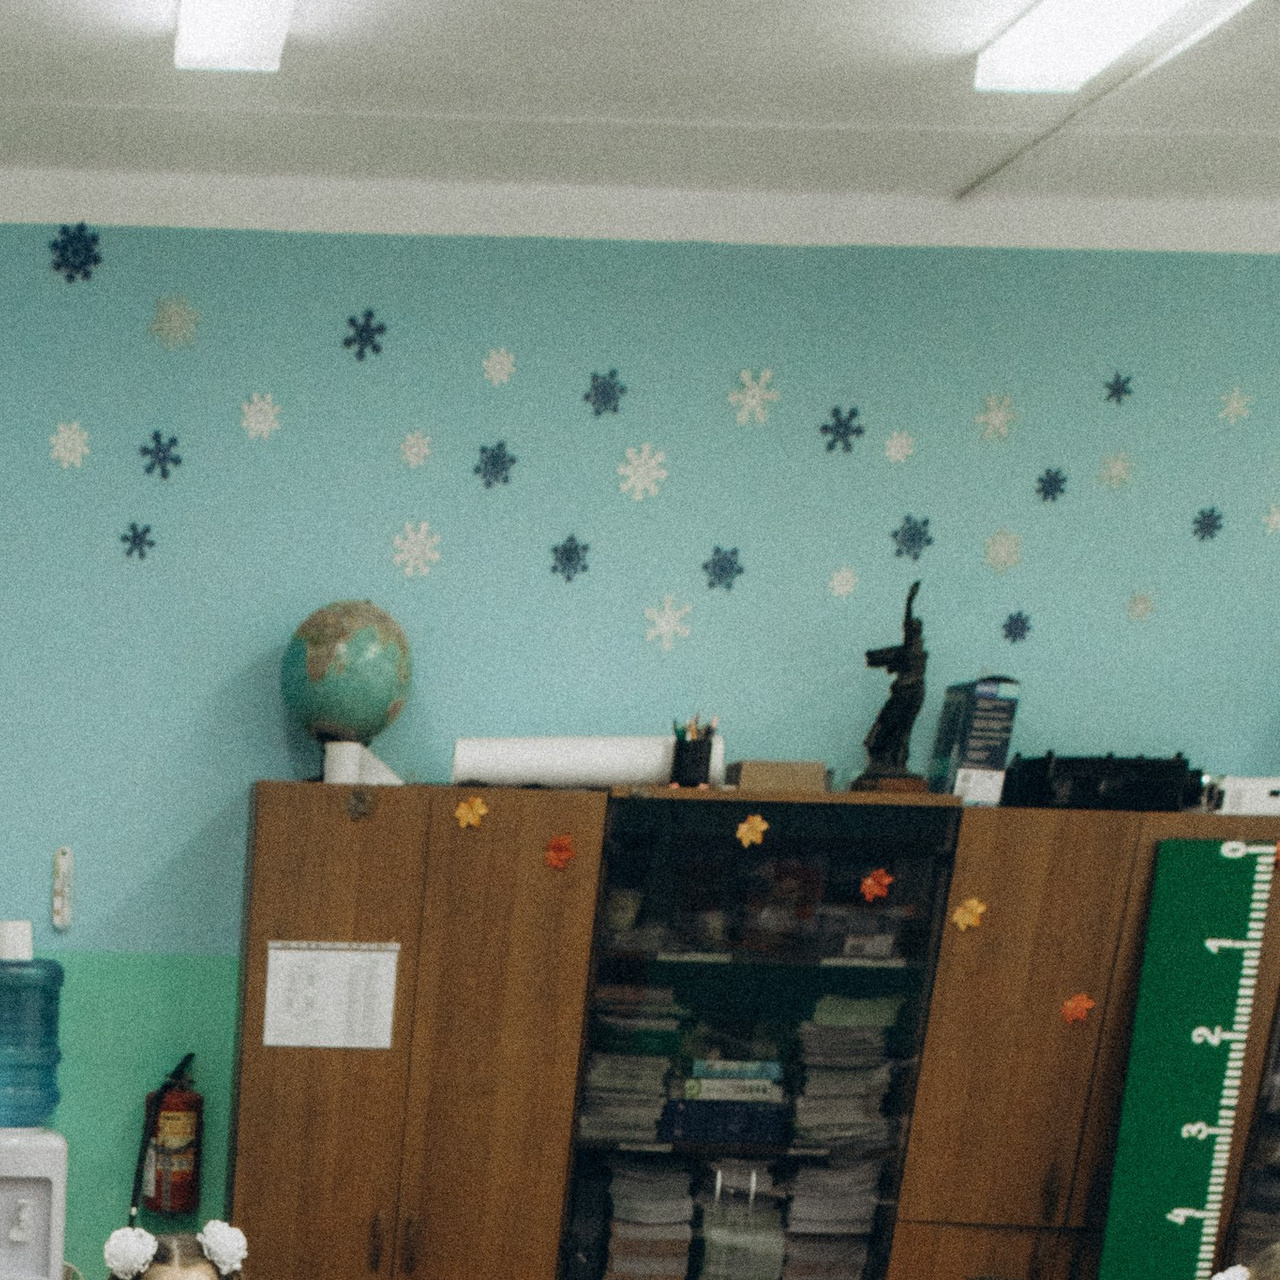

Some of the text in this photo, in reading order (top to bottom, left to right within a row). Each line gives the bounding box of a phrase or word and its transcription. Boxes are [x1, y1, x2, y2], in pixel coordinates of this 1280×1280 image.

[1221, 840, 1246, 859] 0
[1205, 937, 1231, 955] 1
[1192, 1025, 1223, 1046] 2
[1182, 1121, 1210, 1140] 3
[1166, 1206, 1192, 1225] 4
